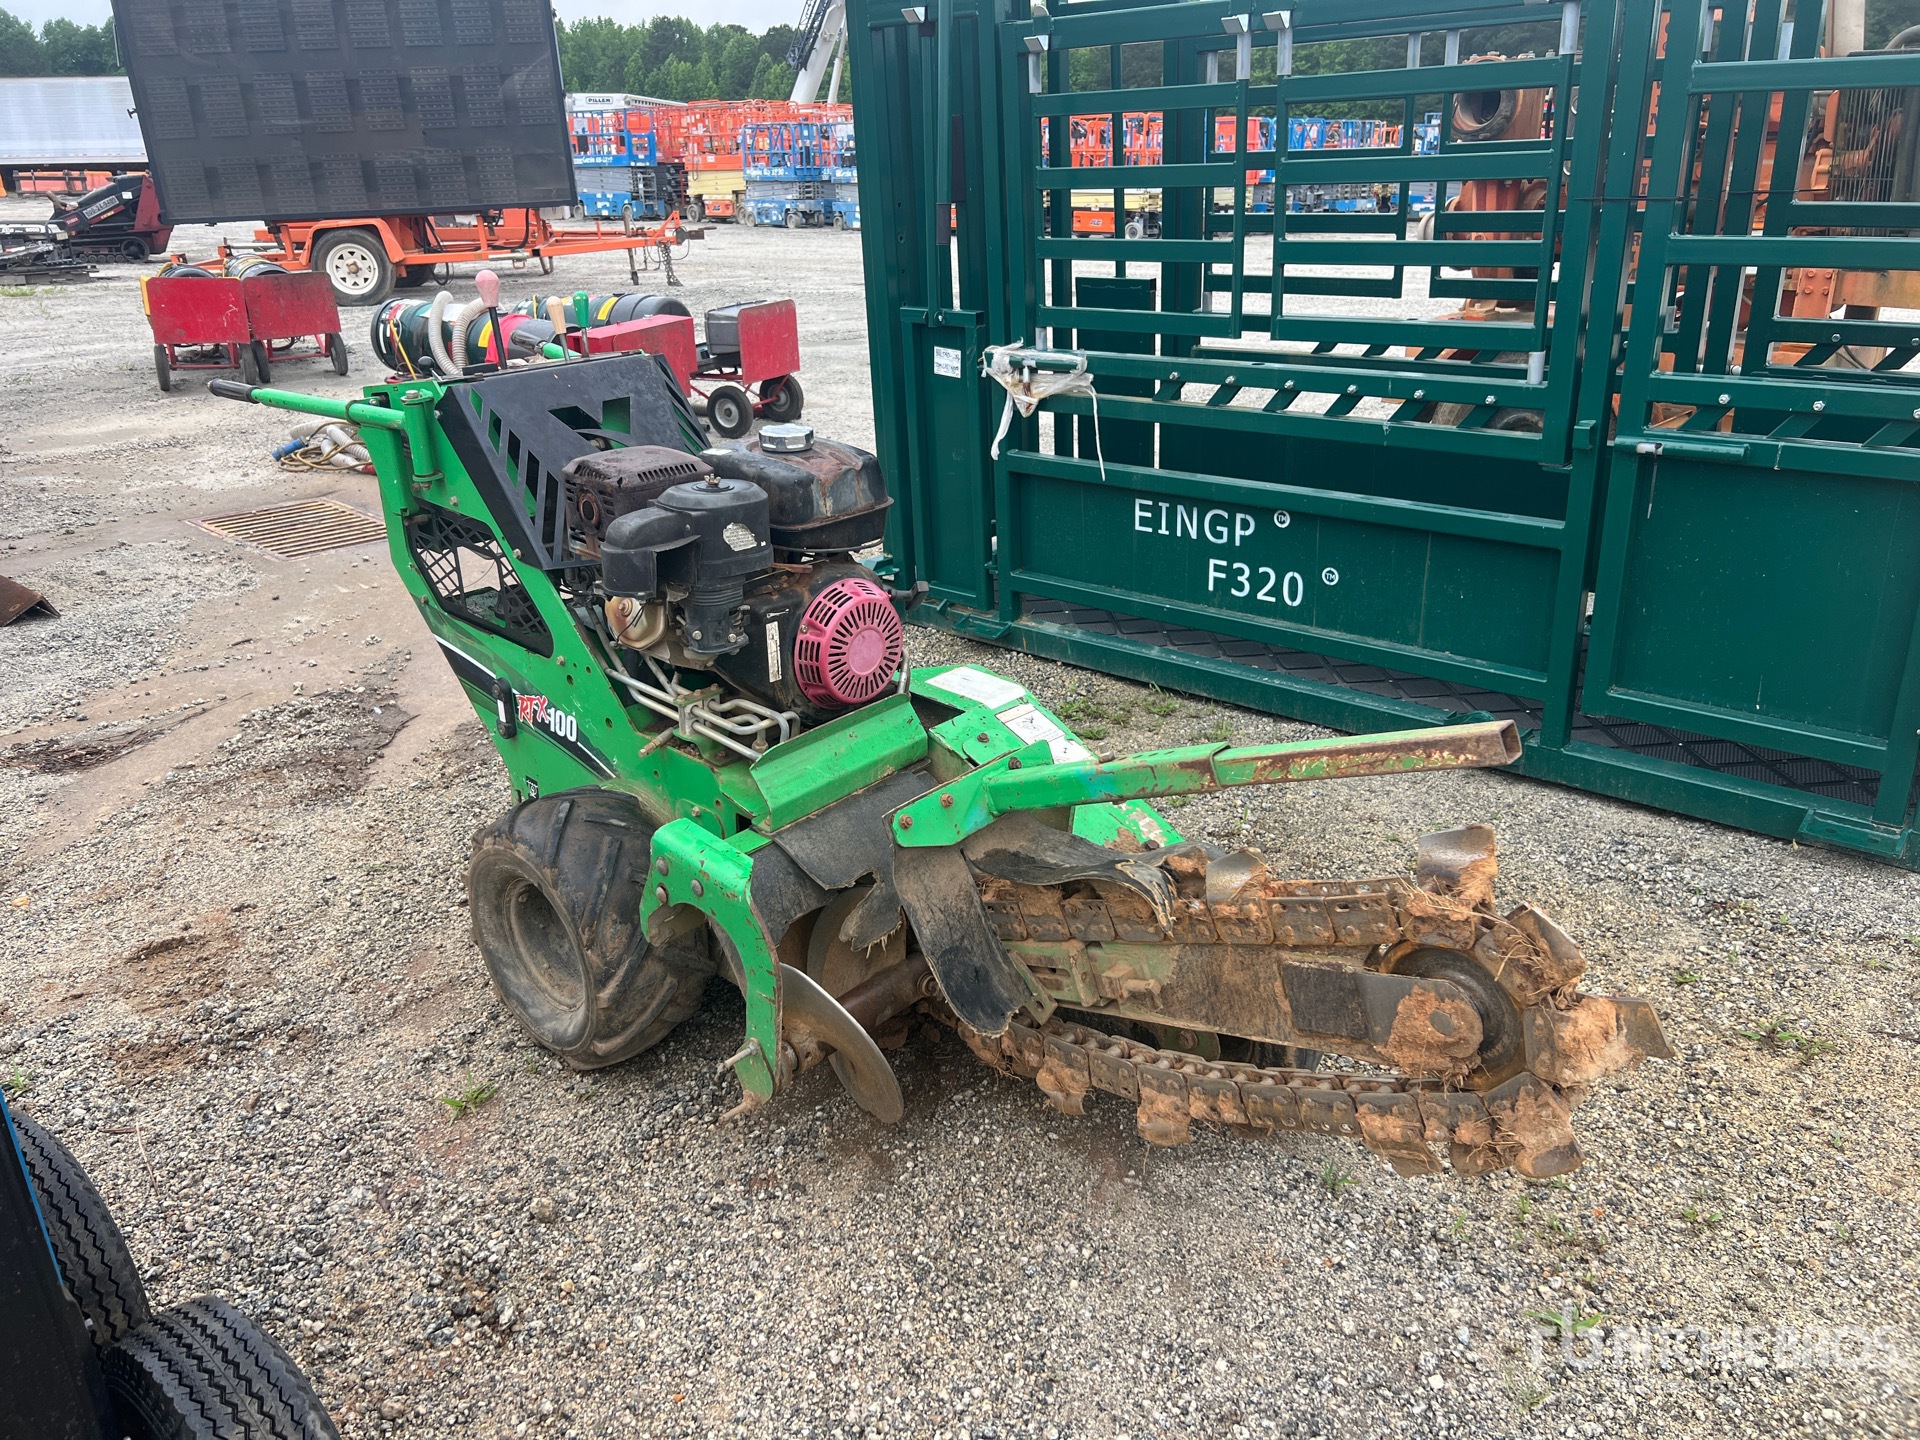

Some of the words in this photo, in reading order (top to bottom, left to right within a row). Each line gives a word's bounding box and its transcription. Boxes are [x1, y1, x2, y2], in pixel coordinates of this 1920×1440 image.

[1134, 498, 1256, 547] EINGP
[1208, 558, 1304, 607] F320
[516, 695, 549, 727] RTX
[547, 707, 578, 742] 100
